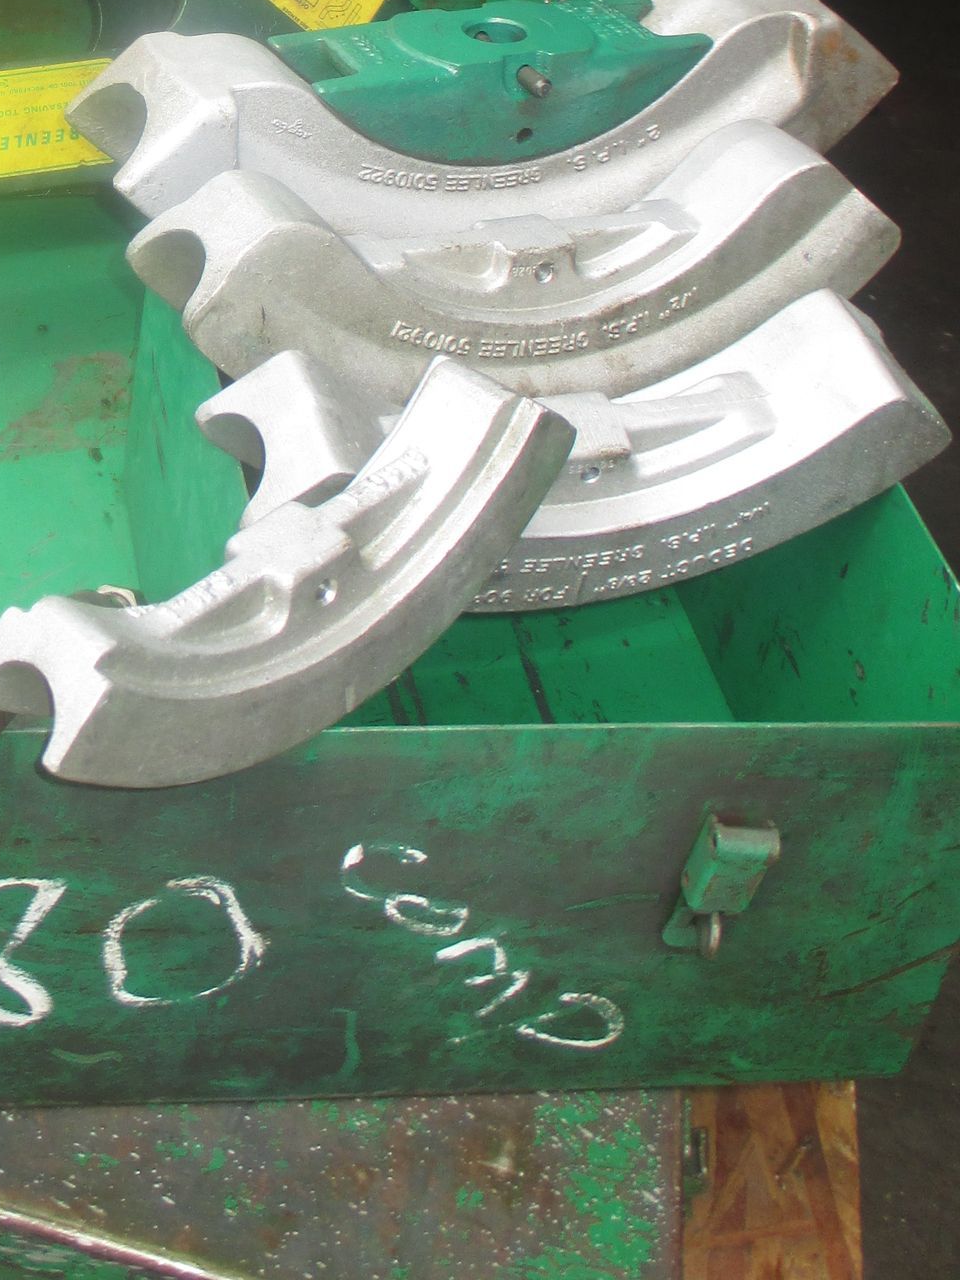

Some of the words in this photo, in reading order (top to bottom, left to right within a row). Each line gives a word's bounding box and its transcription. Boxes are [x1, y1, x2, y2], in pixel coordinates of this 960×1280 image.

[358, 162, 438, 192] 5010922
[445, 166, 540, 193] GREENLEE
[390, 320, 472, 357] 5010921
[478, 330, 589, 359] GREENLEE
[520, 544, 645, 574] GREENLEE
